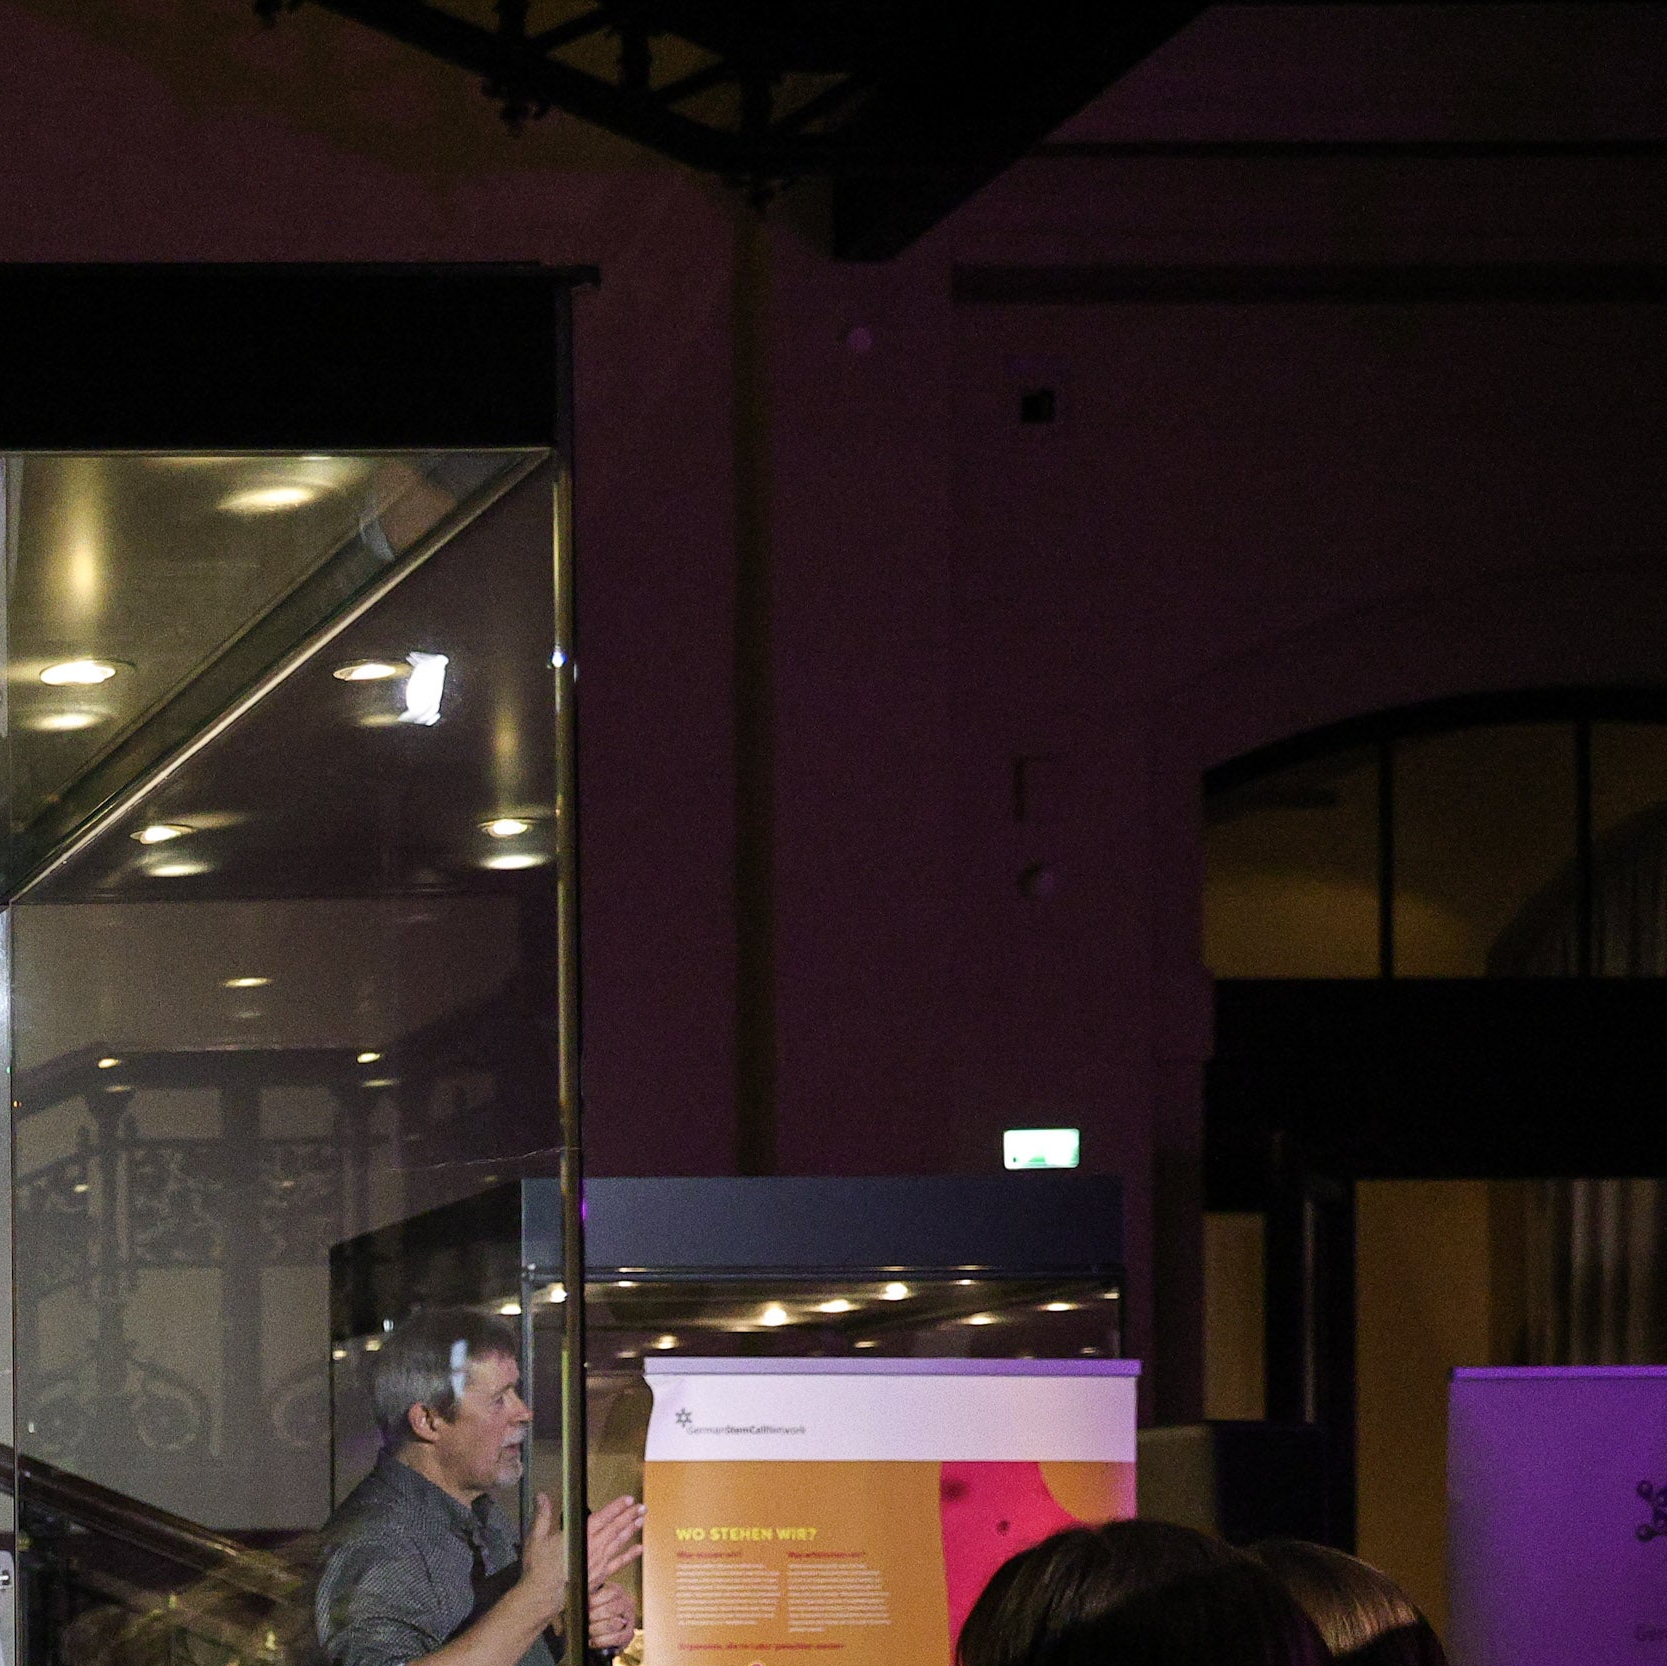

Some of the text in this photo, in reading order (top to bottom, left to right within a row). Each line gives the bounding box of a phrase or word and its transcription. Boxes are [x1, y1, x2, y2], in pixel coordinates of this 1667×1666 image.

[676, 1527, 817, 1541] WO STEHEN WIR?
